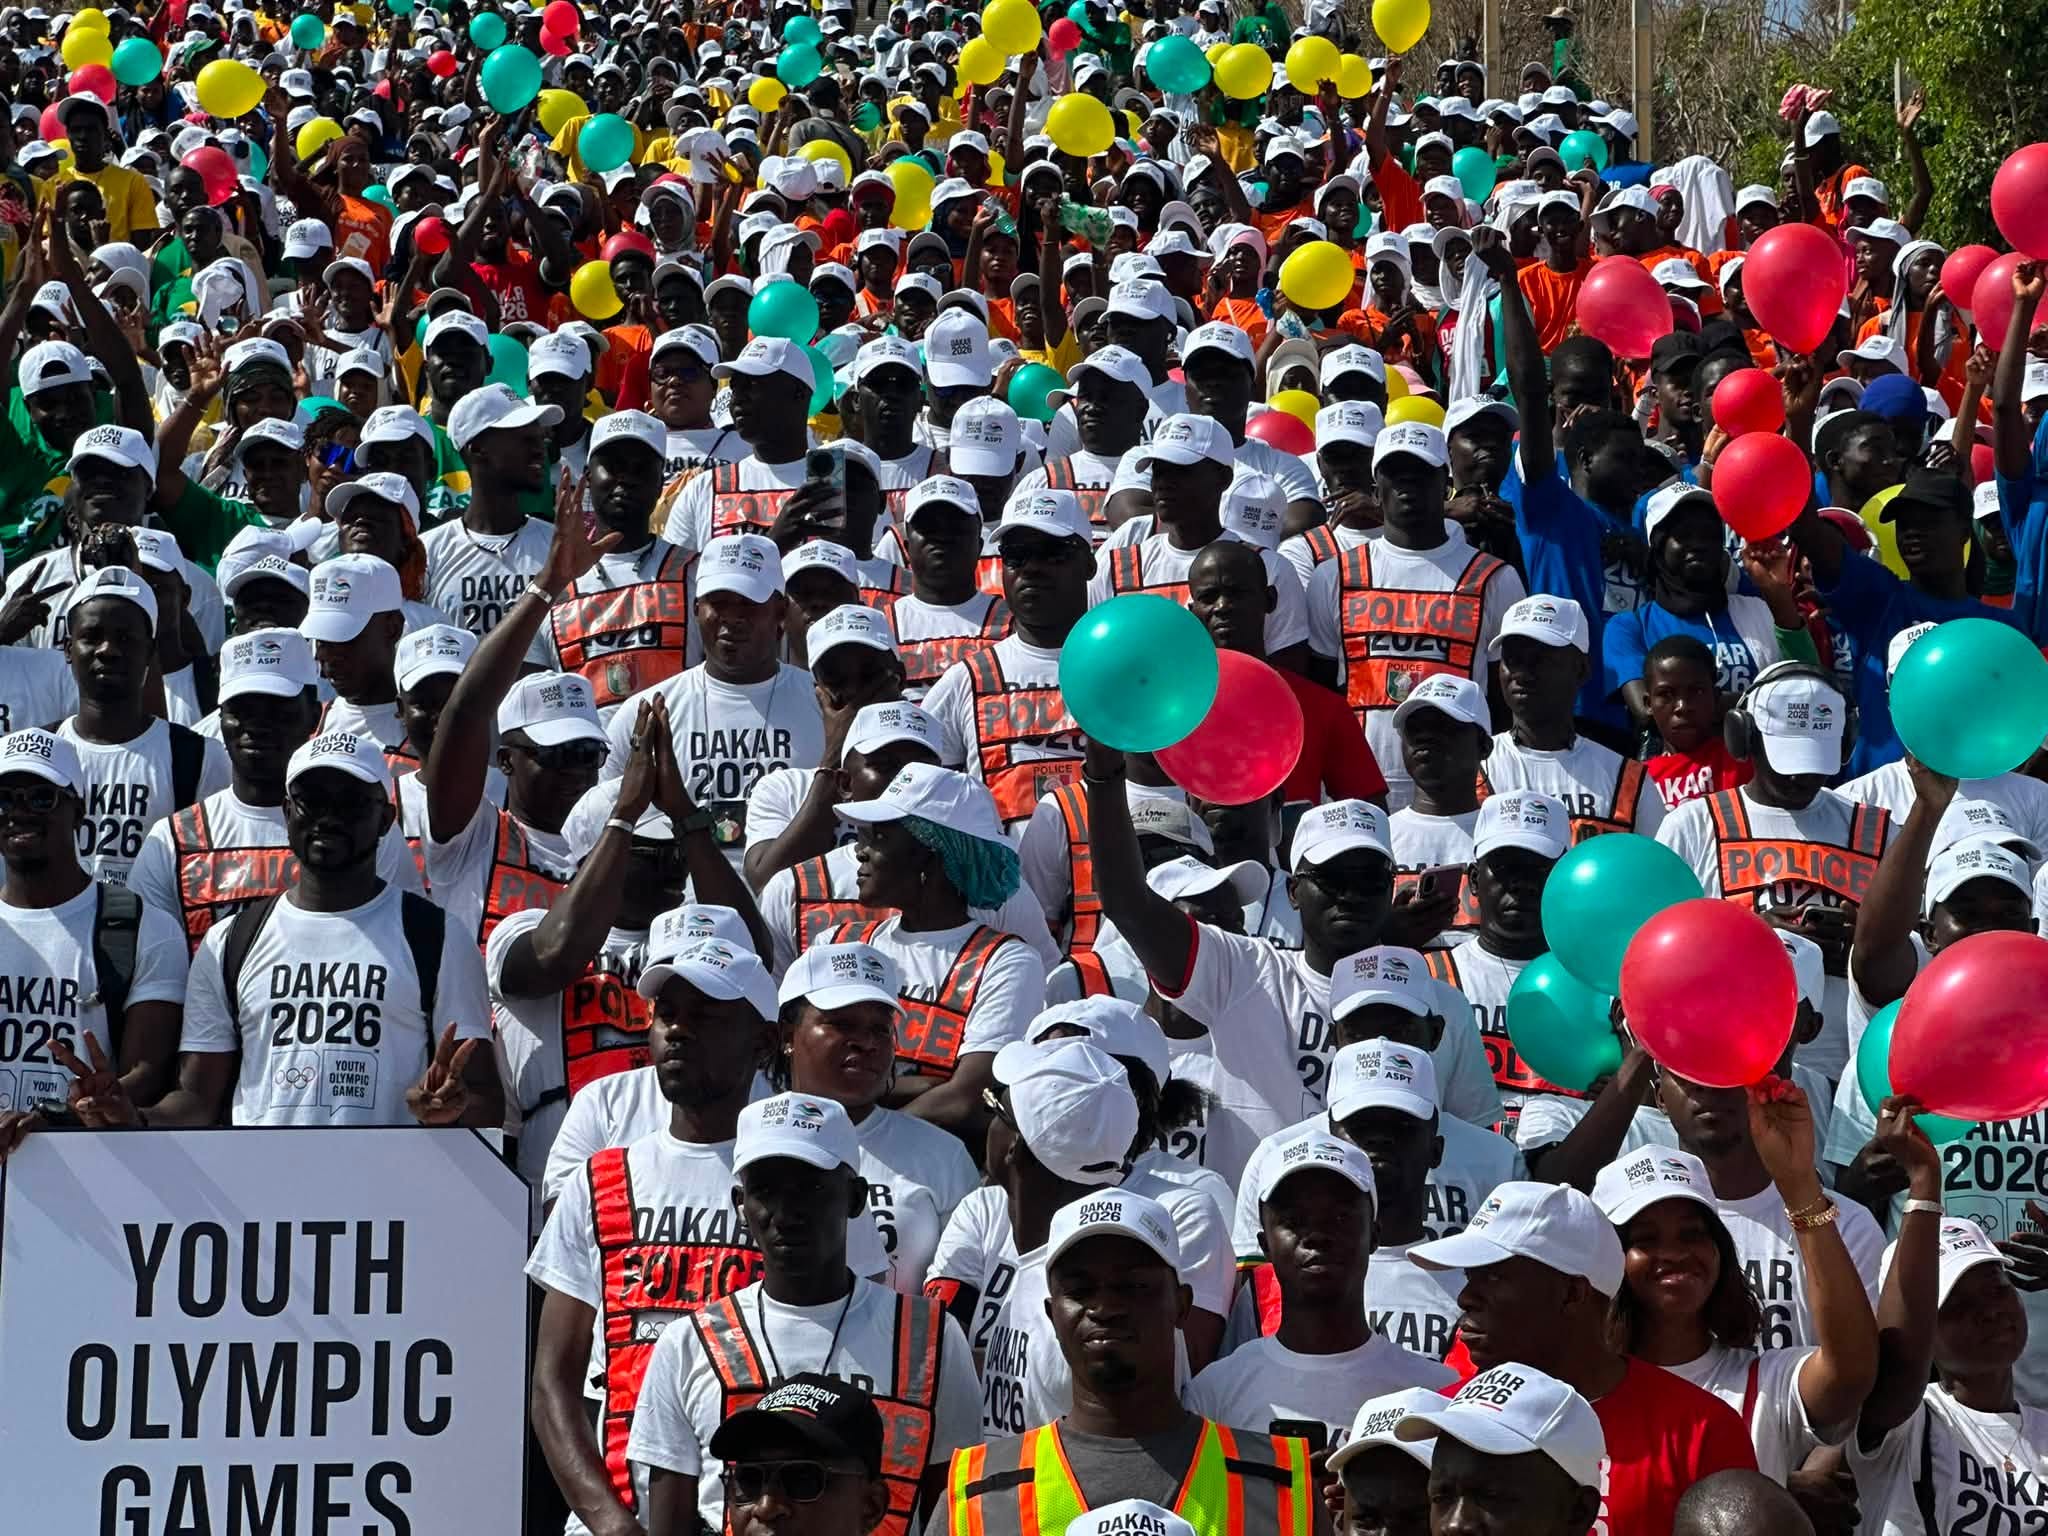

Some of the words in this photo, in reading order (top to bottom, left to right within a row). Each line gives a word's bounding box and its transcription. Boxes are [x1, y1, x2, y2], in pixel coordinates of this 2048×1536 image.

[951, 345, 973, 355] 2026
[741, 561, 761, 572] ASPT
[559, 587, 680, 638] POLICE
[1349, 596, 1475, 637] POLICE
[257, 657, 280, 665] ASPT
[1387, 662, 1423, 673] POLICE
[1788, 703, 1809, 711] DAKAR
[985, 697, 1057, 736] POL
[1787, 711, 1809, 719] 2026
[1812, 723, 1832, 731] ASPT
[8, 733, 54, 748] DAKAR
[311, 731, 357, 748] DAKAR
[690, 729, 791, 760] DAKAR
[5, 743, 51, 757] 2026
[310, 741, 355, 757] 2026
[1033, 765, 1073, 775] POLICE
[691, 762, 790, 801] 202
[83, 784, 149, 817] KAR
[1323, 806, 1347, 816] DAKAR
[1324, 812, 1347, 823] 2026
[1354, 822, 1376, 832] ASPT
[1524, 816, 1547, 826] ASPT
[77, 818, 142, 858] 026
[187, 852, 300, 899] POLIC
[1728, 846, 1876, 897] POLICE
[688, 930, 714, 938] ASPT
[699, 956, 727, 969] ASPT
[833, 961, 858, 971] 2026
[1355, 956, 1378, 966] DAKAR
[1354, 963, 1378, 973] 2026
[270, 962, 387, 1000] DAKAR
[1383, 973, 1408, 985] ASPT
[0, 976, 79, 1018] AKAR
[271, 1001, 381, 1047] 2026
[0, 1019, 76, 1065] 026
[335, 1060, 366, 1071] YOUTH
[329, 1075, 369, 1085] OLYMPIC
[1385, 1071, 1412, 1084] ASPT
[332, 1086, 365, 1098] GAMES
[763, 1100, 789, 1110] DAKAR
[762, 1107, 788, 1118] 2026
[792, 1120, 822, 1132] ASPT
[1314, 1154, 1344, 1164] ASPT
[1627, 1165, 1655, 1181] 2026
[1663, 1173, 1691, 1184] ASPT
[1080, 1201, 1122, 1214] DAKAR
[1079, 1210, 1121, 1225] 2026
[1953, 1239, 1977, 1250] ASPT
[123, 1220, 405, 1318] YOUTH
[986, 1326, 1029, 1378] DAKAR
[1475, 1370, 1525, 1392] AKAR
[66, 1338, 453, 1441] OLYMPIC
[1454, 1384, 1513, 1405] 2026
[1367, 1407, 1405, 1425] DAKAR
[100, 1461, 412, 1536] GAMES
[1098, 1513, 1166, 1535] DAKAR
